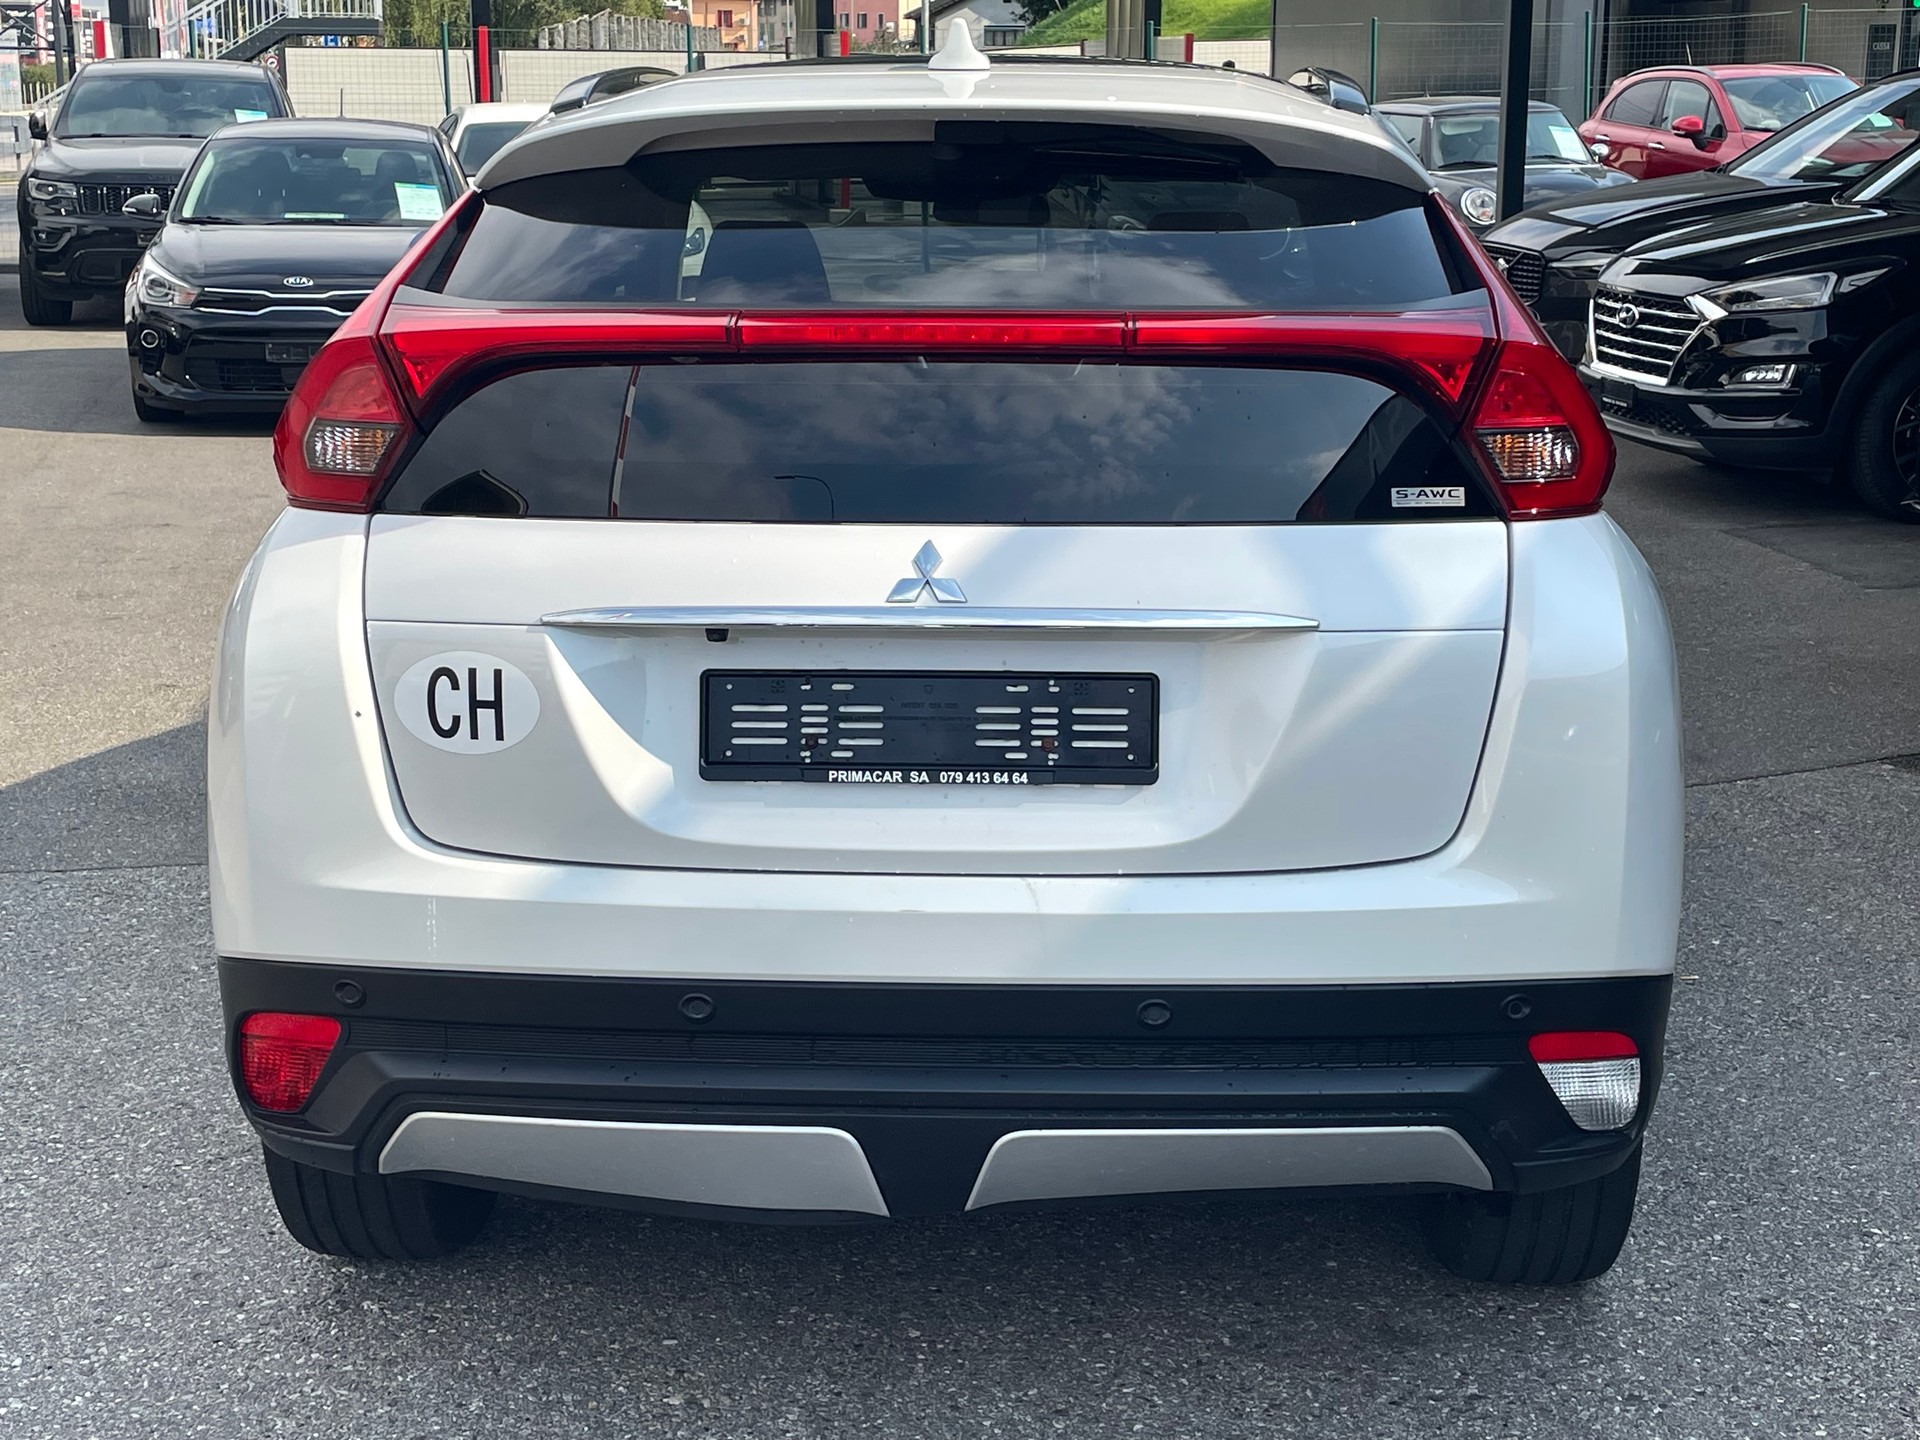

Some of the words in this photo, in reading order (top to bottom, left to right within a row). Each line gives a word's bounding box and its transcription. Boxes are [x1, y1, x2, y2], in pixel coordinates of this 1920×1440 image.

[287, 277, 309, 285] KIA
[1395, 488, 1460, 499] S-AWC
[427, 666, 505, 741] CH
[828, 770, 903, 783] PRIMACAR
[909, 771, 929, 783] SA
[939, 772, 963, 784] 079
[966, 772, 990, 784] 413
[993, 772, 1009, 784] 64
[1012, 773, 1029, 785] 64
